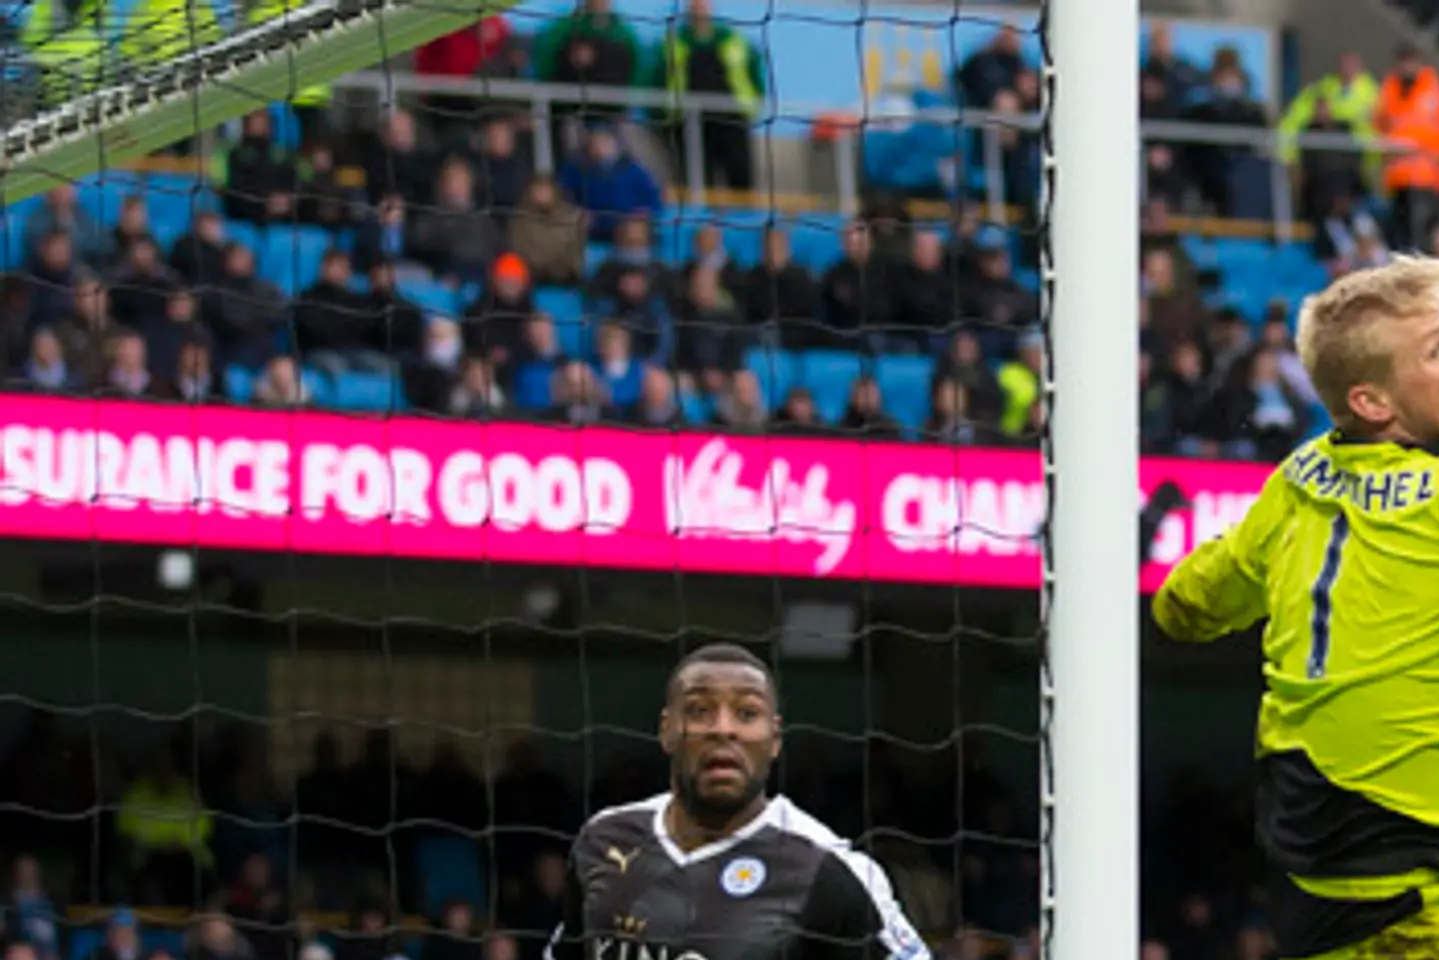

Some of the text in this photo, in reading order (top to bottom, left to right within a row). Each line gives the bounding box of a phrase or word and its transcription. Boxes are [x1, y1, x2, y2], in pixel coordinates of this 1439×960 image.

[302, 444, 432, 525] FOR
[439, 451, 632, 535] GOOD
[664, 440, 856, 574] Vitality
[1307, 511, 1350, 680] 1
